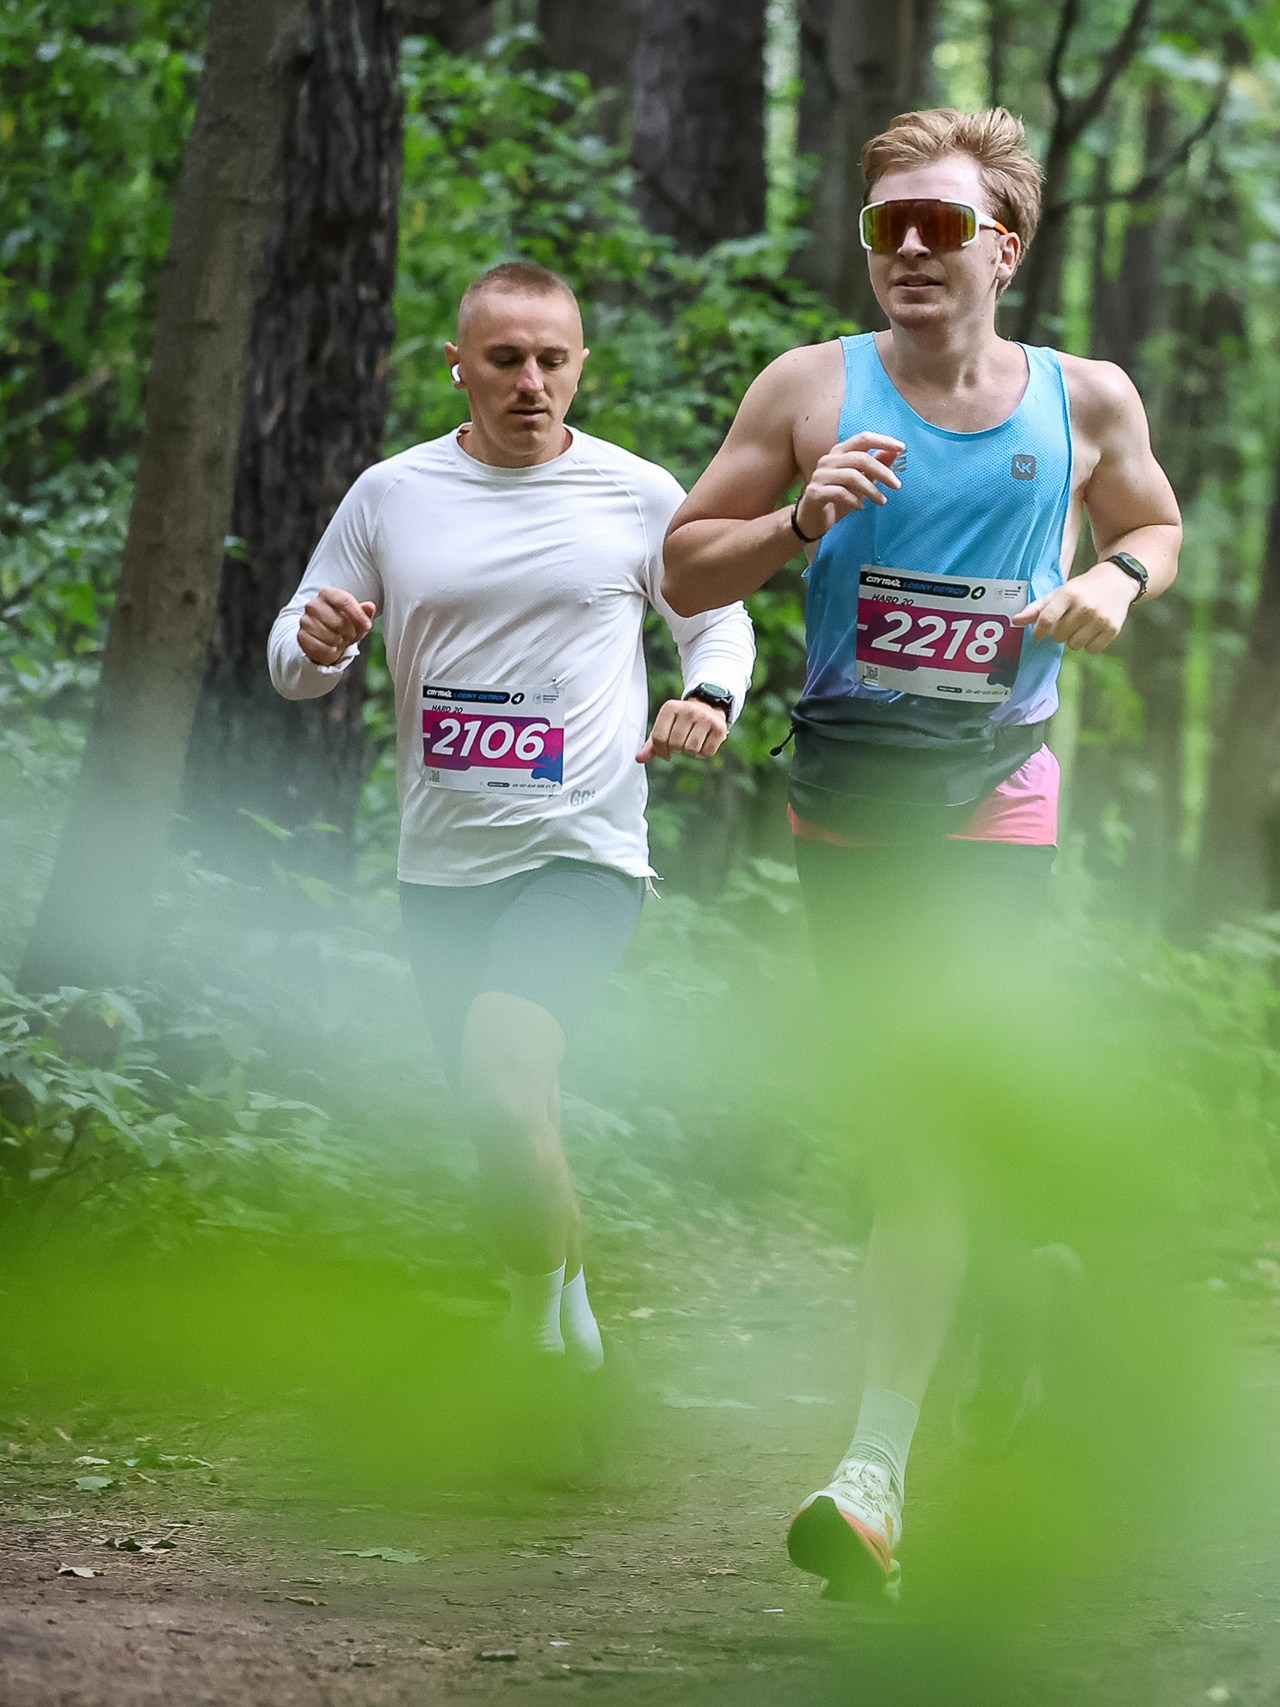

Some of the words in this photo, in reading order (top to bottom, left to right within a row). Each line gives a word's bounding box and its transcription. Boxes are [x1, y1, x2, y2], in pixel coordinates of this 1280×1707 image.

[872, 593, 900, 605] HARD
[901, 598, 915, 607] 20
[871, 611, 1004, 663] 2218
[431, 705, 452, 713] HARD
[431, 718, 551, 761] 2106
[570, 789, 596, 807] GR
